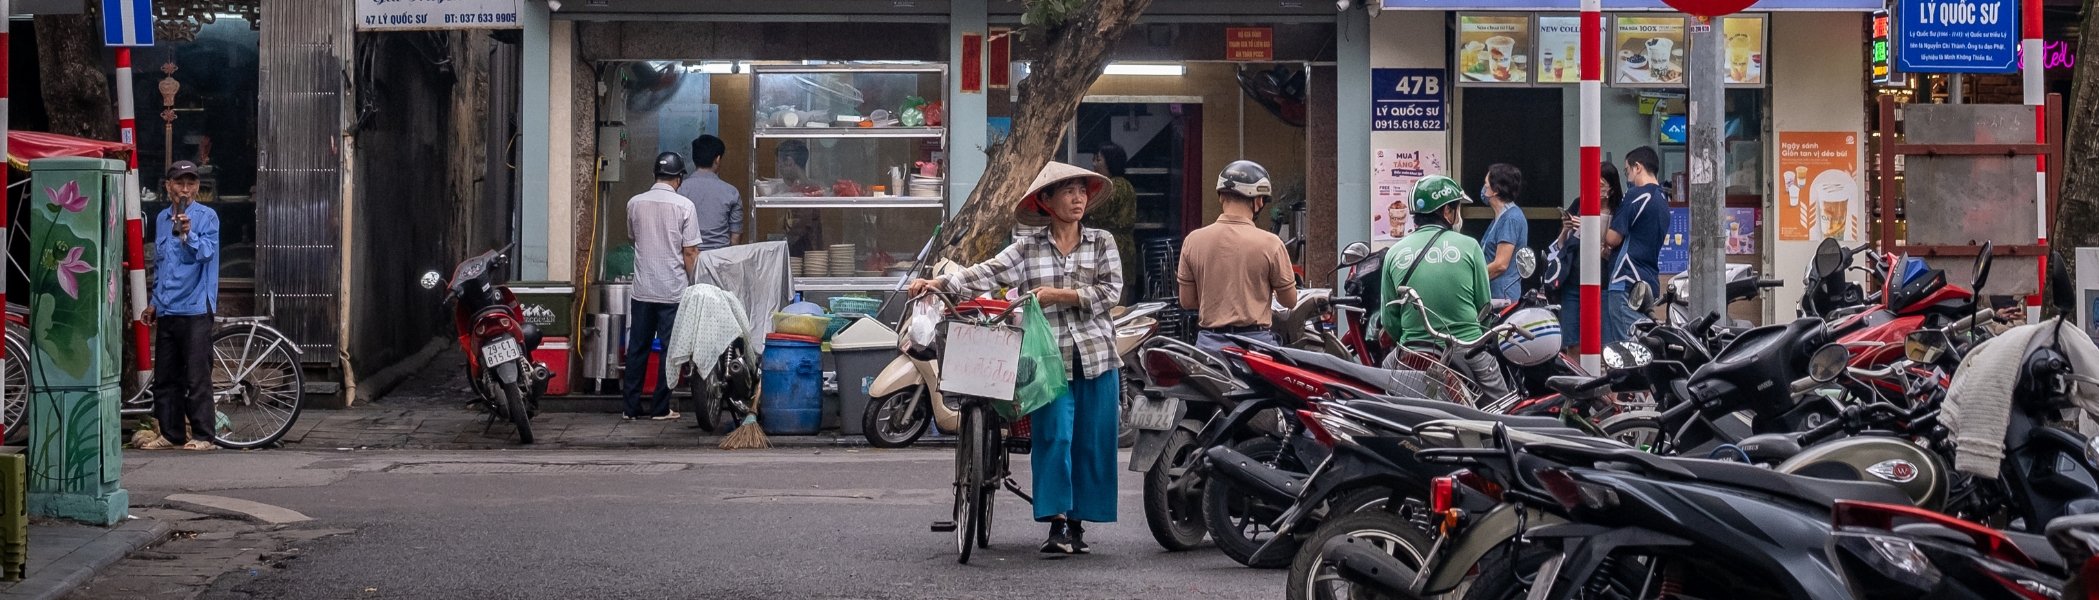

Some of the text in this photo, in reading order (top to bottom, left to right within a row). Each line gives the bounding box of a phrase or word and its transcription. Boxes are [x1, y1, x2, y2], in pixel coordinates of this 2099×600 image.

[365, 11, 428, 25] 47 LÝ QUỐC SƯ
[460, 13, 475, 23] 037
[477, 13, 493, 23] 633
[495, 13, 516, 23] 9905
[1979, 1, 2000, 24] SƯ
[1395, 76, 1439, 95] 47B
[1376, 103, 1440, 116] LÝ QUỐC SƯ
[1375, 120, 1440, 129] 0915.618.622
[1413, 150, 1420, 160] 1
[1431, 186, 1452, 200] Grab
